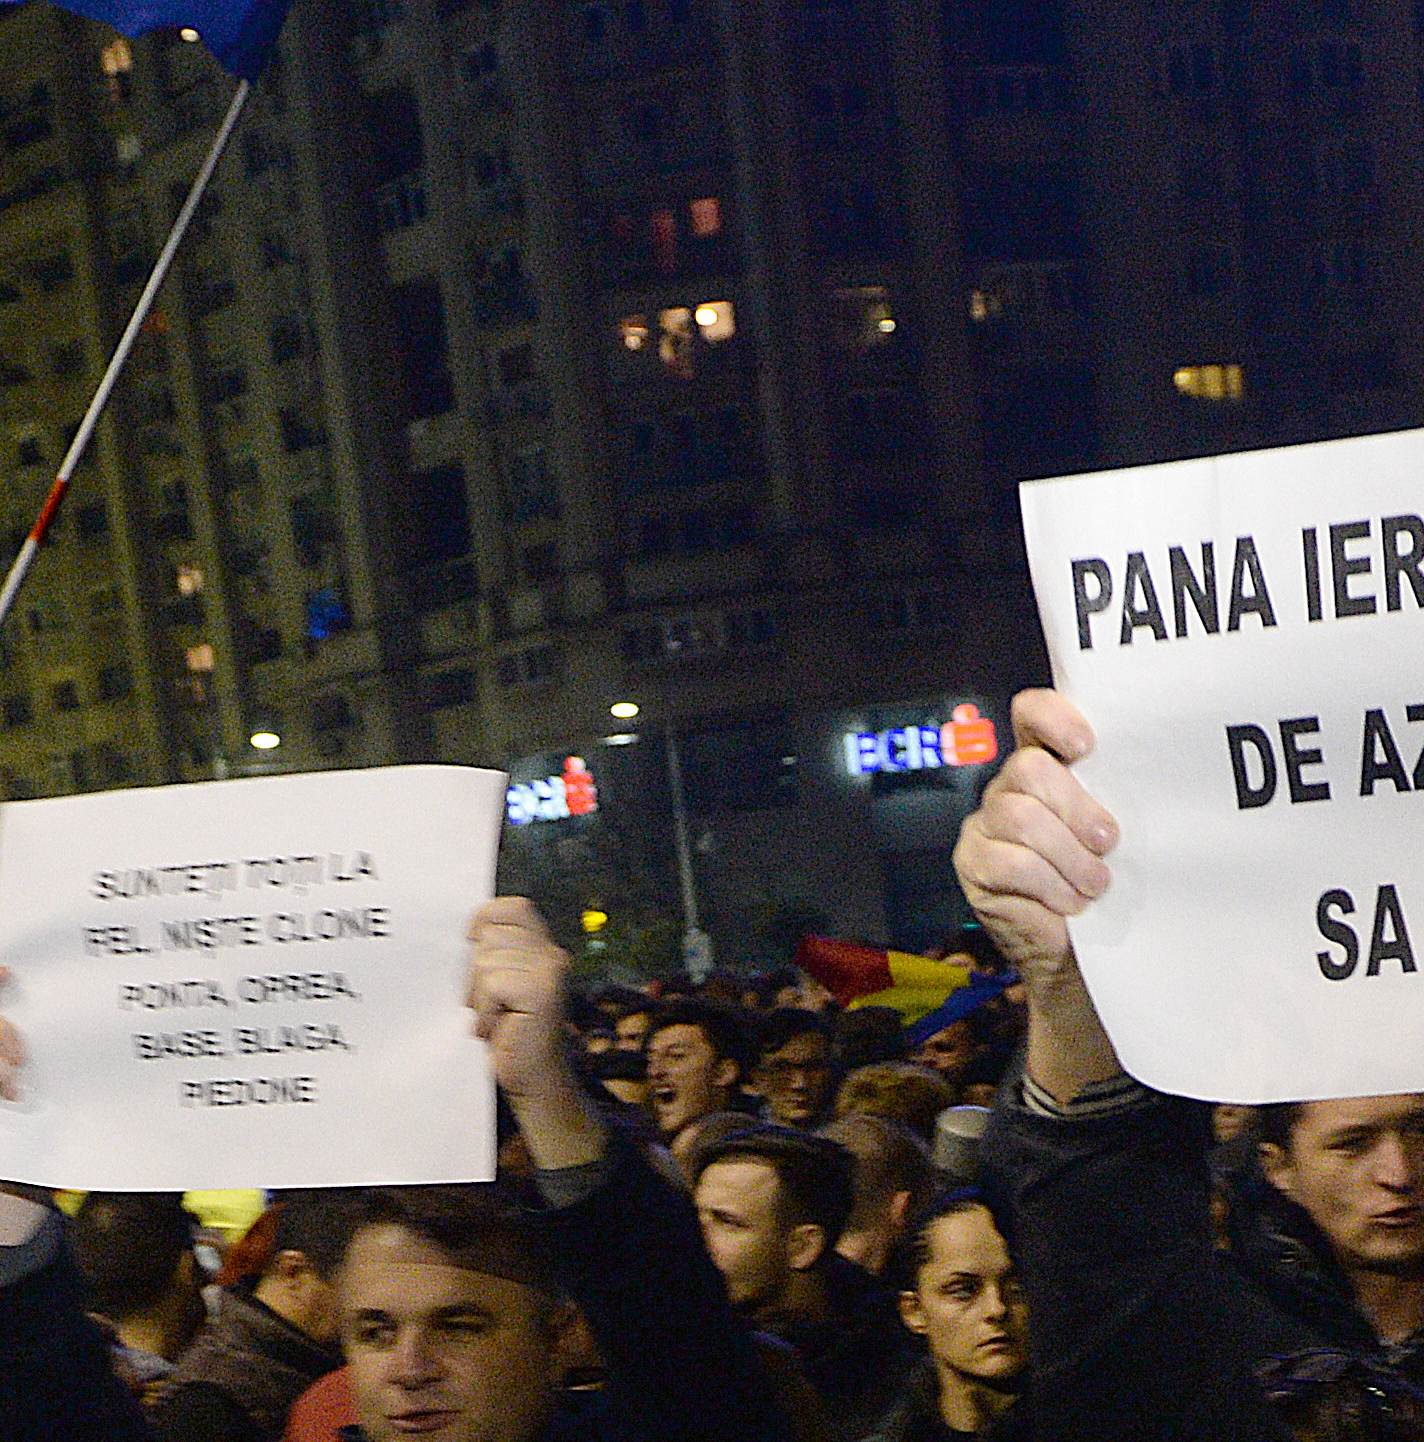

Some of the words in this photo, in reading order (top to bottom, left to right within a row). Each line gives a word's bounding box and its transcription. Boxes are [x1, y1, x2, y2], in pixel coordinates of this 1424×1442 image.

[1071, 536, 1277, 650] PANA
[844, 726, 944, 775] BCR
[1226, 717, 1331, 810] DE
[328, 848, 379, 881] LA
[273, 903, 391, 945] CLONE
[1316, 885, 1417, 981] SA
